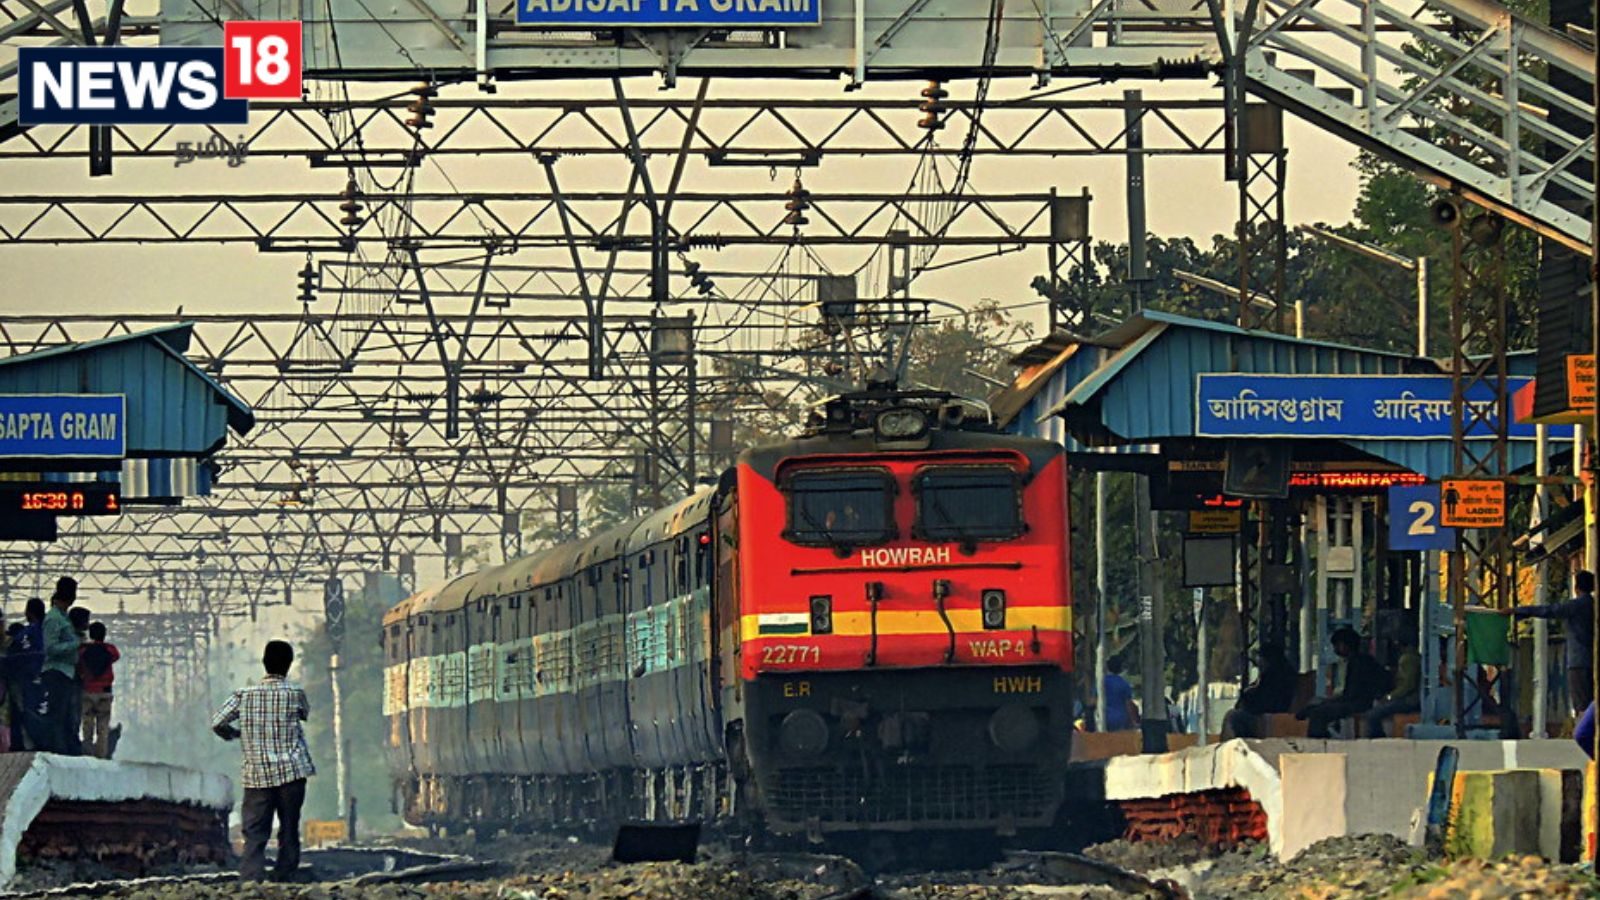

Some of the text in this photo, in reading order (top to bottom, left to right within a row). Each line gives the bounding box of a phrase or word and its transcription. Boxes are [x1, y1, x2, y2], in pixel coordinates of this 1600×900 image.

[1207, 388, 1344, 423] আদিসপ্তগ্রাম
[60, 412, 117, 440] GRAM
[1320, 473, 1368, 487] TRAIN
[22, 493, 68, 510] 16:30
[106, 493, 118, 510] 1
[1408, 500, 1436, 536] 2
[861, 547, 950, 567] HOWRAH
[762, 645, 820, 664] 22771
[969, 639, 1025, 657] WAP 4
[993, 676, 1042, 693] HWH
